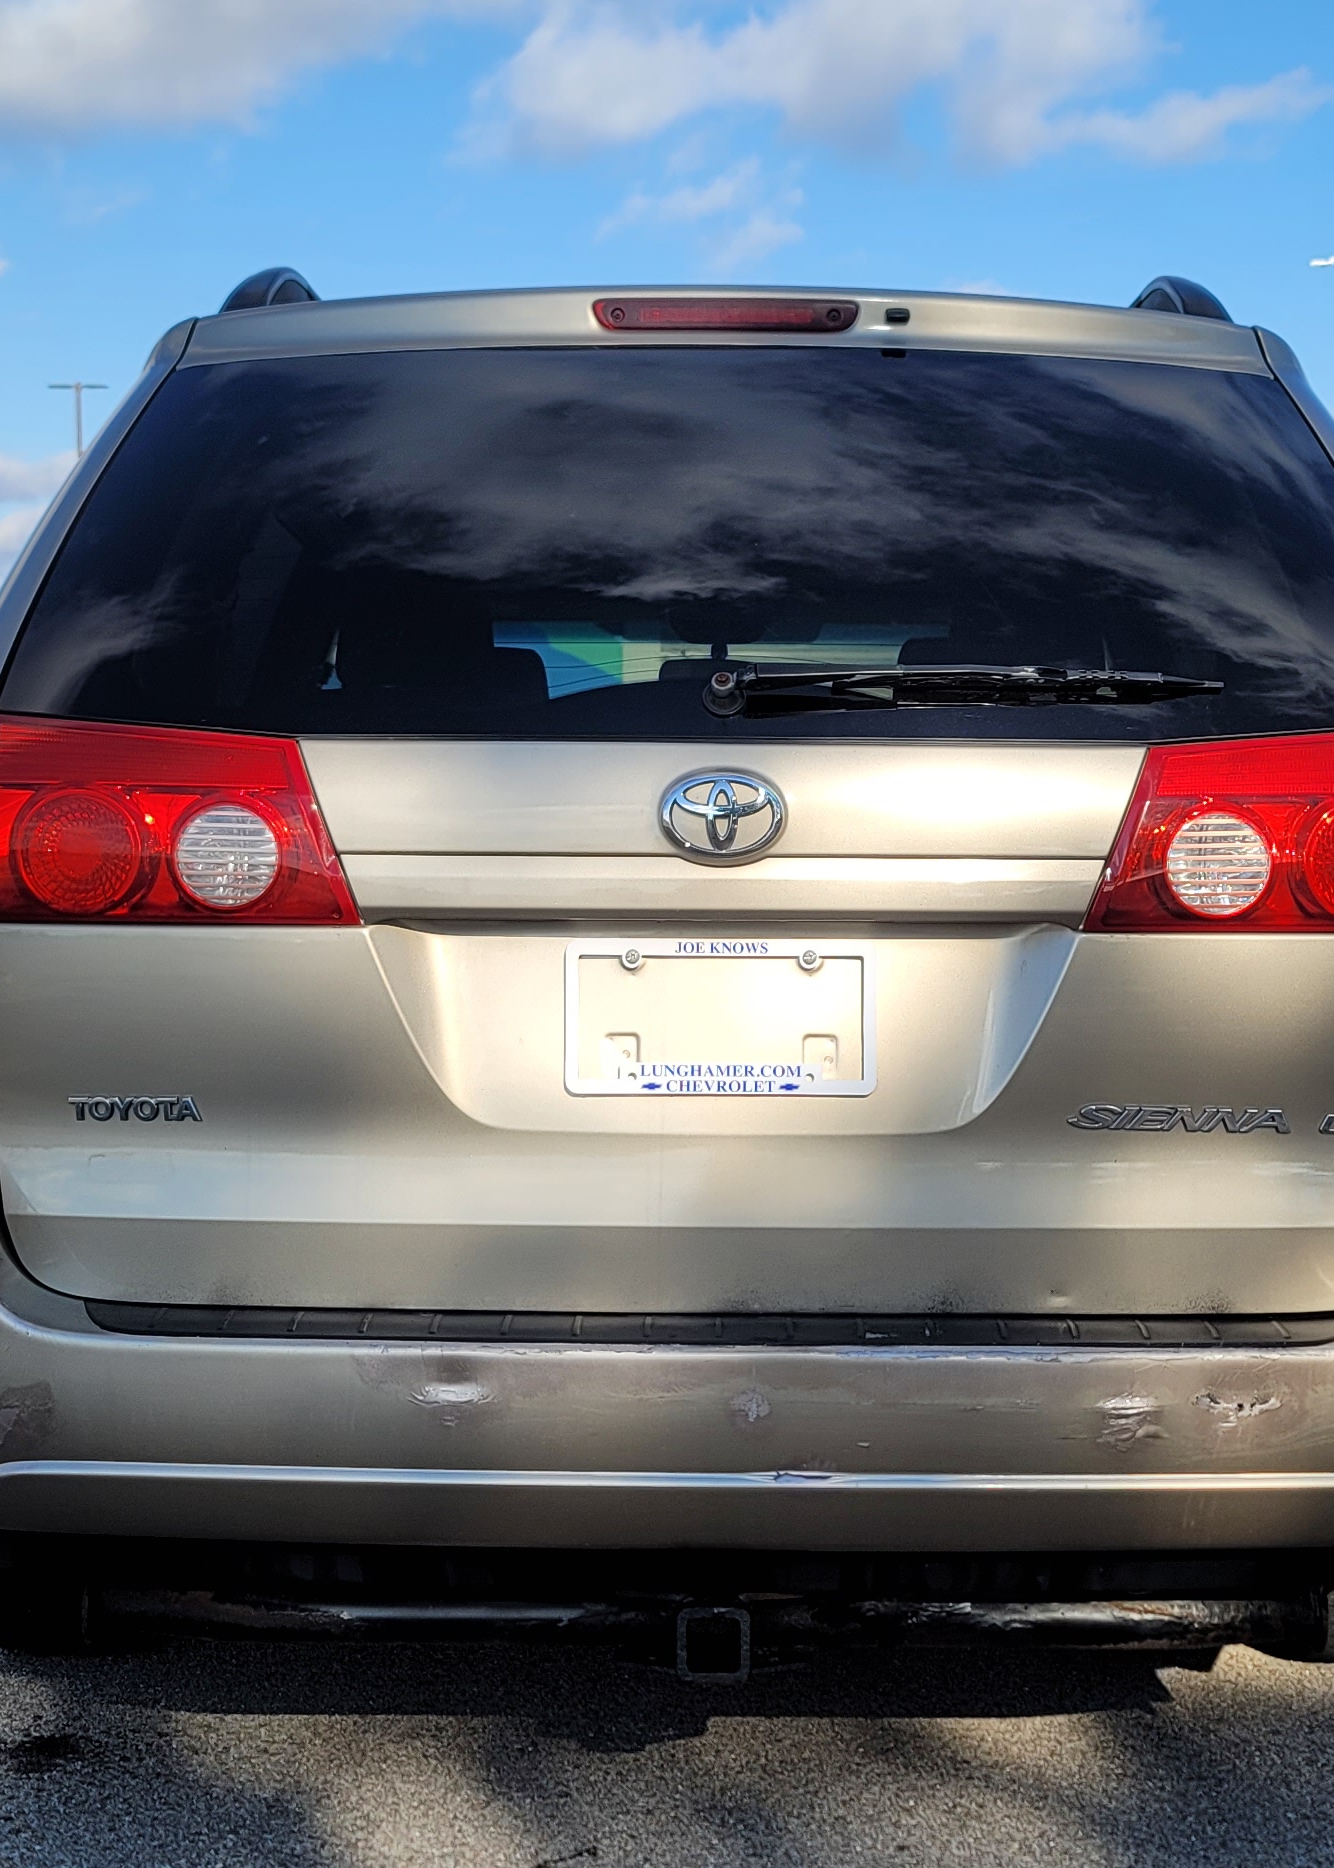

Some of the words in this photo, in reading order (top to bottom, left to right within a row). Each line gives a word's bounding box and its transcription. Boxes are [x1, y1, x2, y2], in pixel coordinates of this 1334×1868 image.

[675, 941, 705, 954] JOE
[710, 941, 769, 954] KNOWS
[640, 1064, 802, 1079] LUNGHAMER.COM
[666, 1080, 776, 1093] CHEVROLET
[68, 1094, 203, 1121] TOYOTA
[1067, 1103, 1292, 1134] SIENNA
